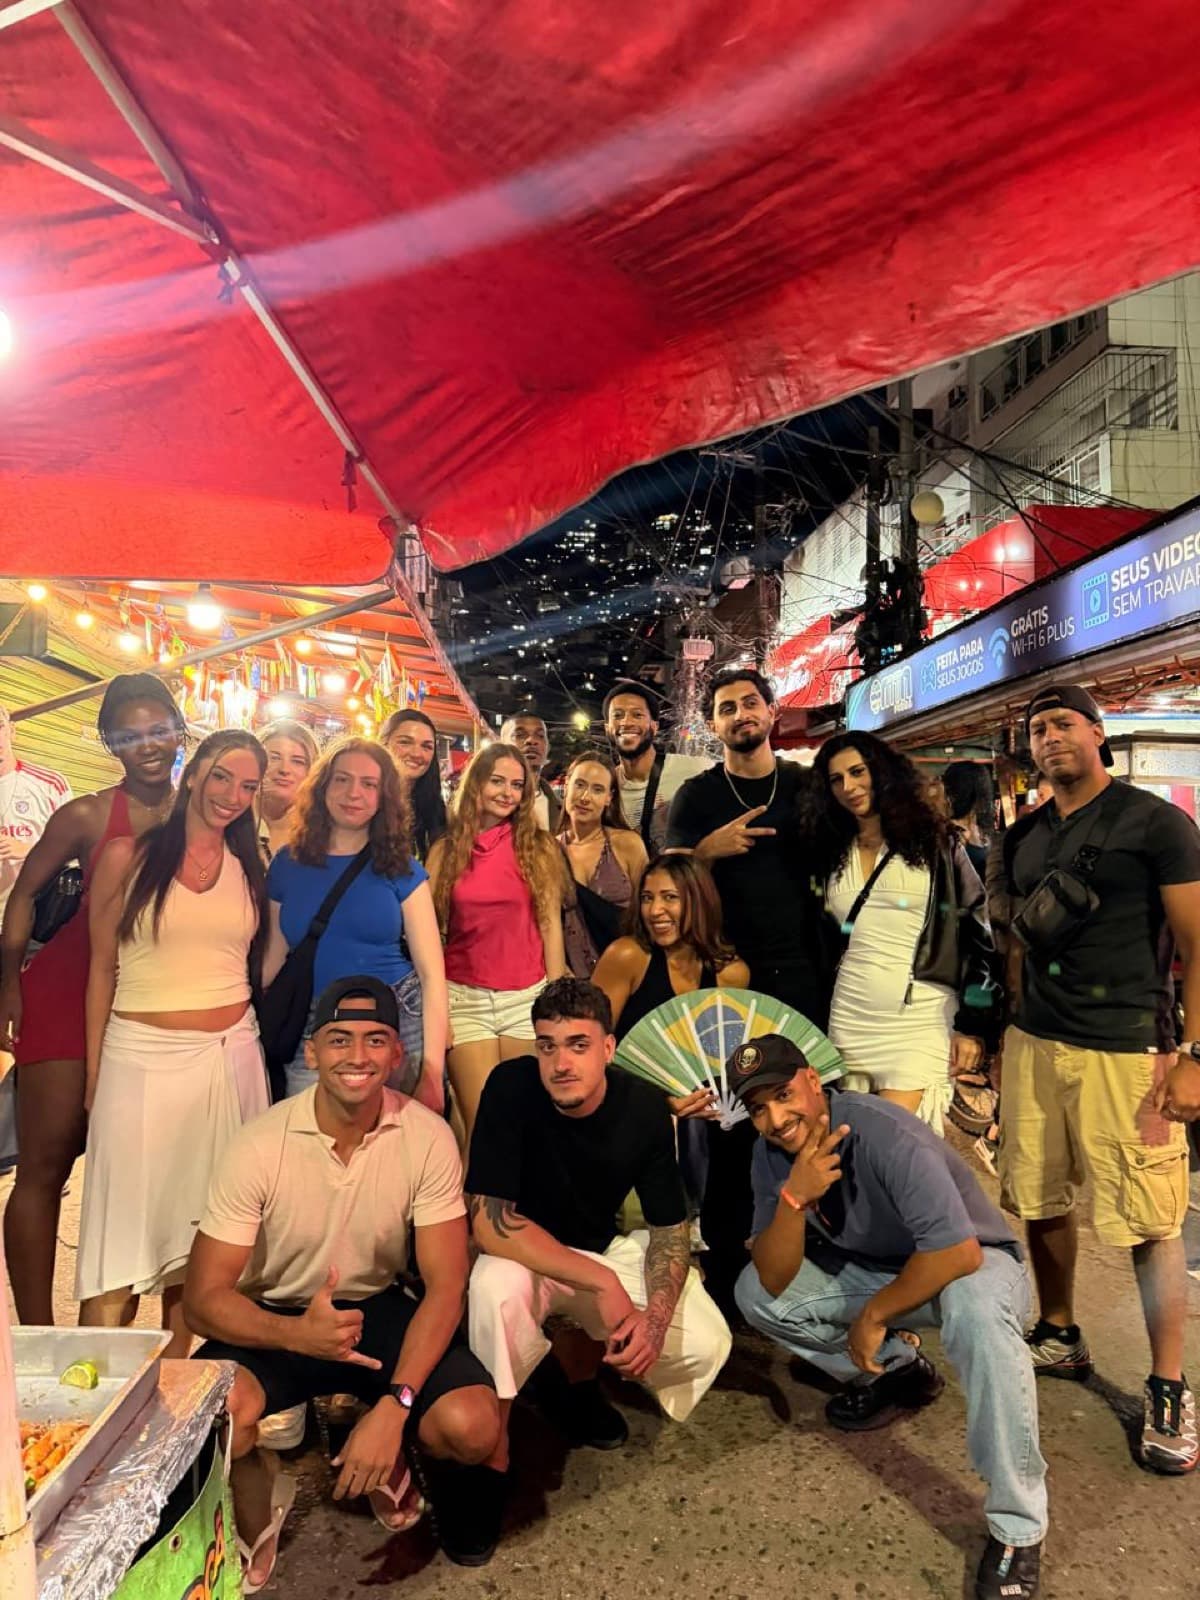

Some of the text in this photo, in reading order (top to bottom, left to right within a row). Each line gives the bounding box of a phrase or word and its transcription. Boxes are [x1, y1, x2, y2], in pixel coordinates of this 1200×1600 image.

[1111, 557, 1150, 592] SEUS
[1113, 587, 1141, 619] SEM
[1011, 606, 1048, 637] GRÁTIS
[1012, 616, 1075, 657] WI-FI 6 PLUS
[937, 637, 984, 670] FEITA PARA
[937, 659, 984, 689] SEUS JOGOS
